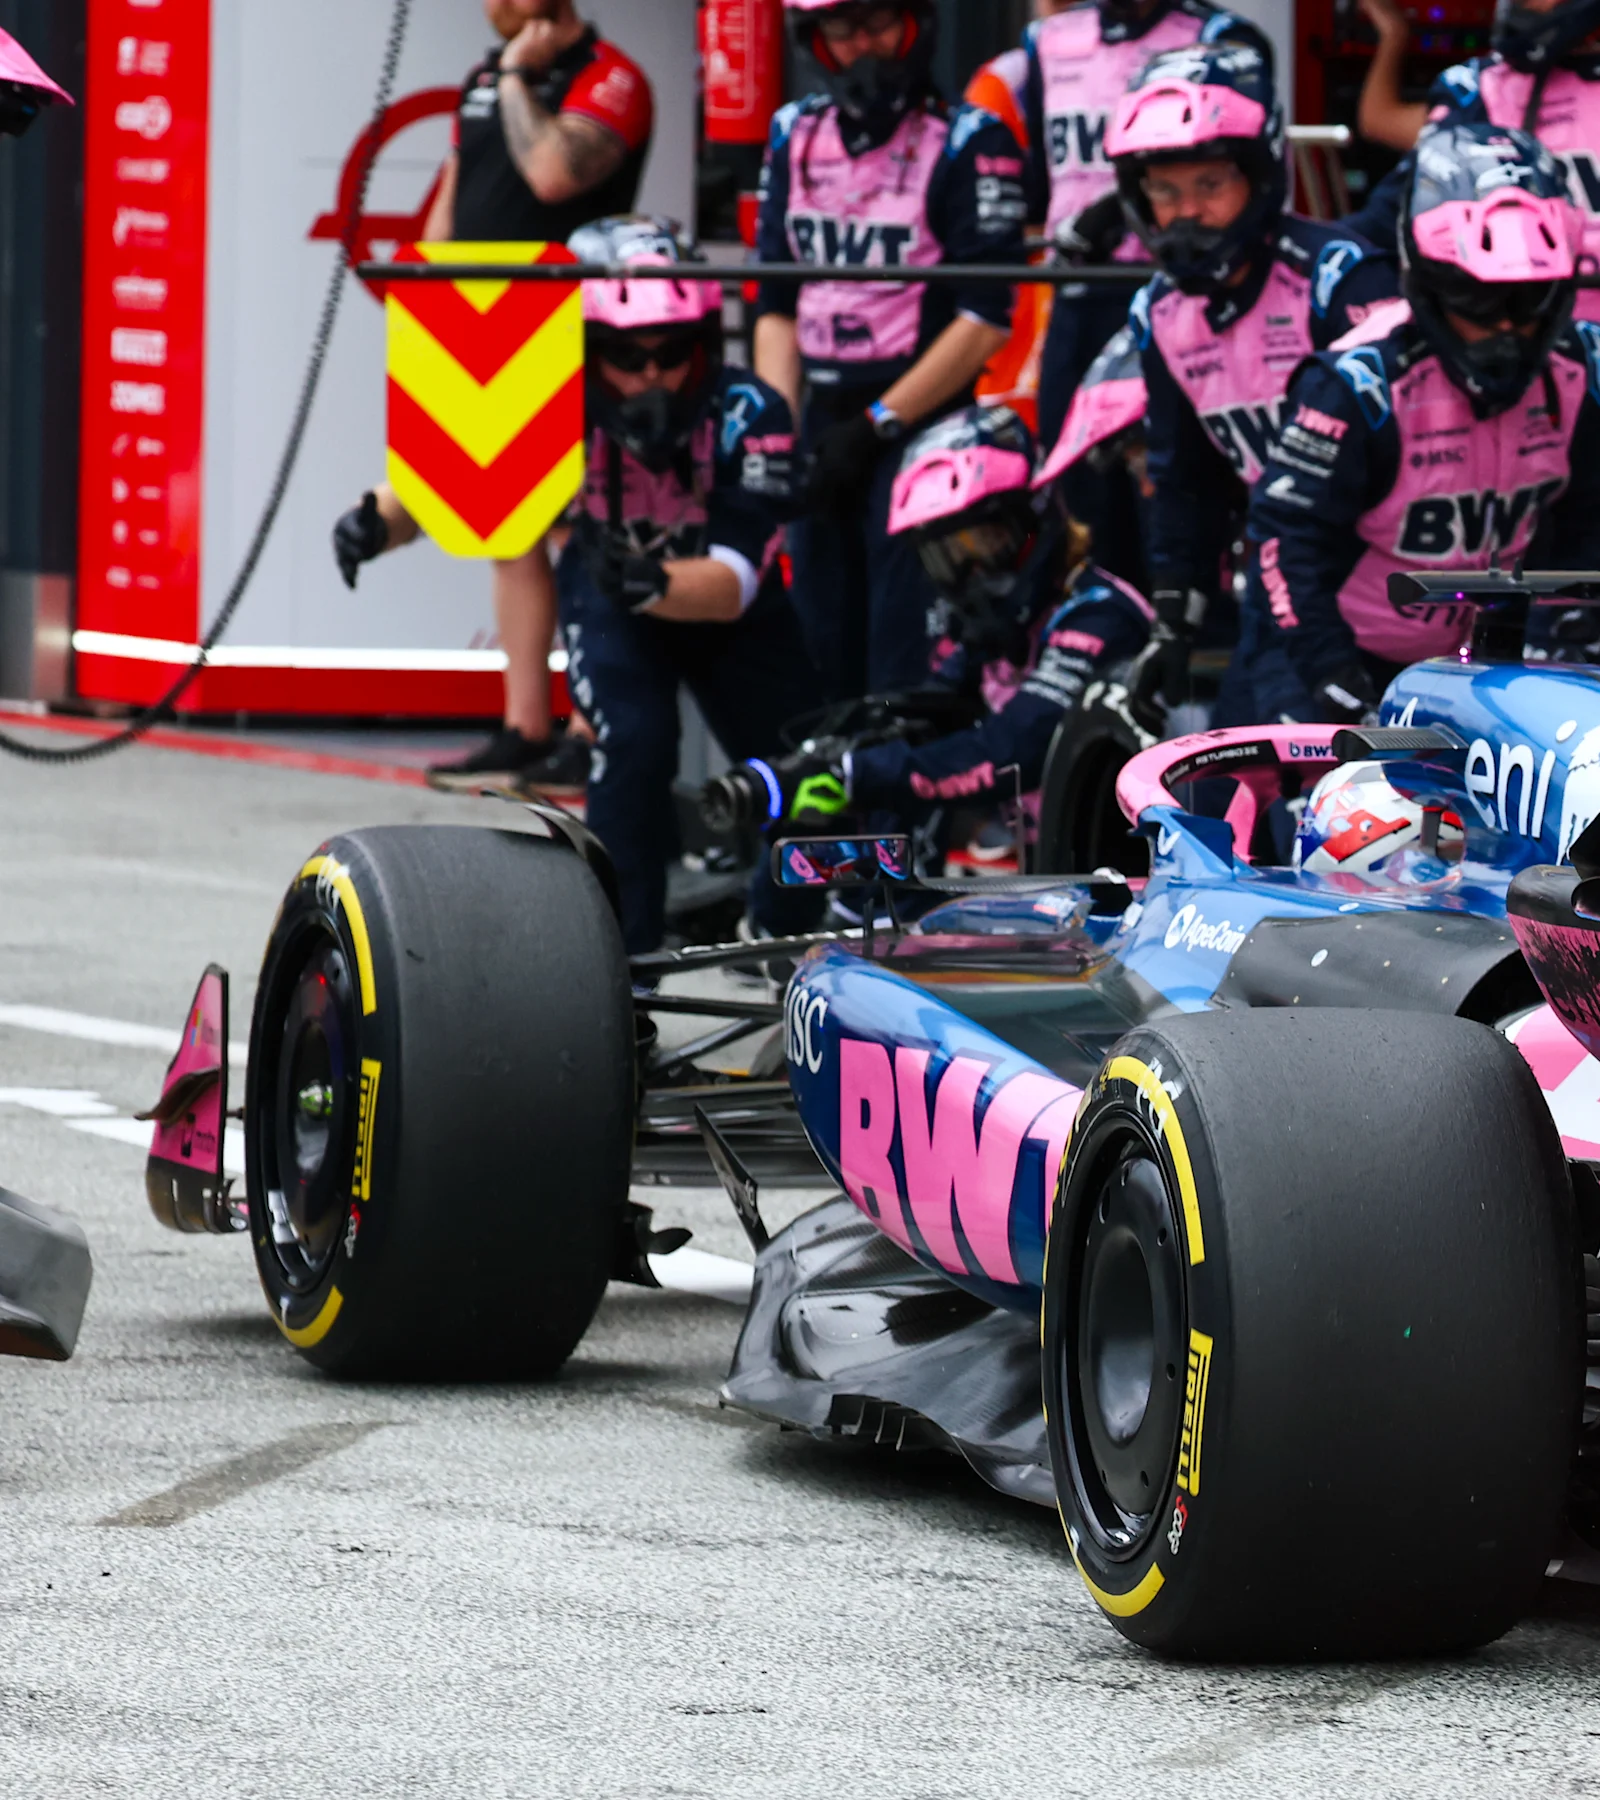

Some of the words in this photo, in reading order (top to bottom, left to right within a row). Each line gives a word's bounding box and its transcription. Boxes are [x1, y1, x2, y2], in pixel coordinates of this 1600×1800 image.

[1464, 719, 1578, 839] eni
[1181, 913, 1247, 955] ApeCoin
[1176, 1327, 1214, 1498] PIRELLI
